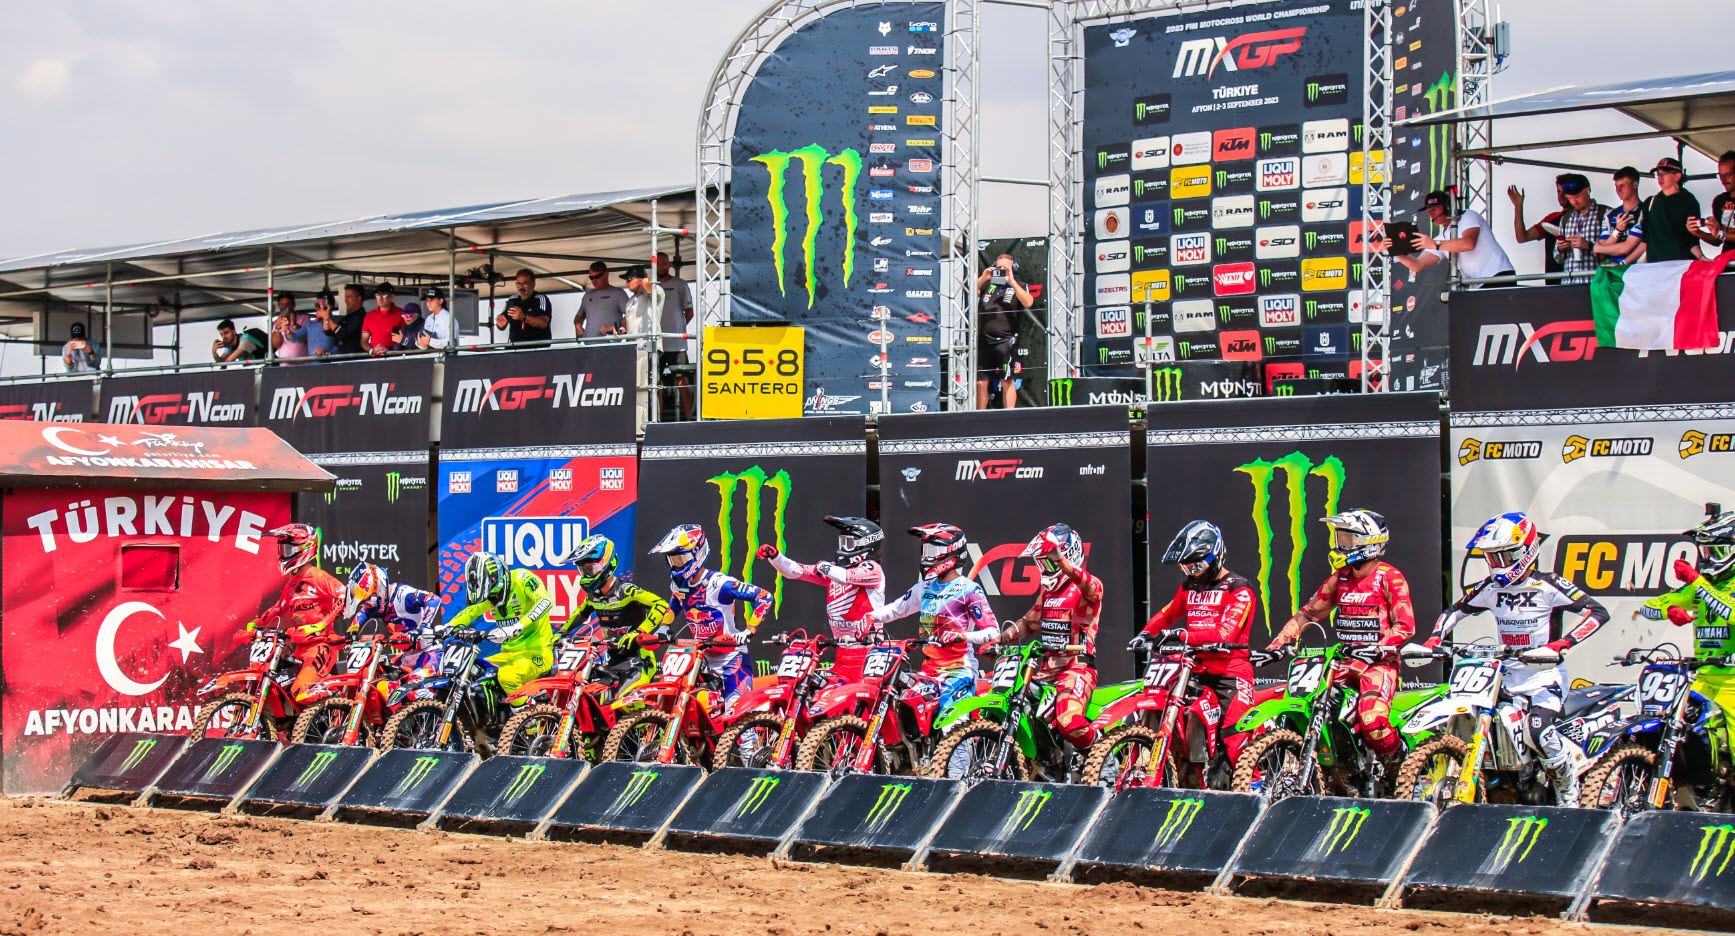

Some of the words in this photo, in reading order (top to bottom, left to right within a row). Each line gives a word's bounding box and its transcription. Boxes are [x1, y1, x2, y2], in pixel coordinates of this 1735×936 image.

[1166, 24, 1184, 34] 2023
[1185, 22, 1199, 31] FIM
[1199, 17, 1245, 29] MOTOCROSS
[1246, 12, 1273, 24] WORLD
[1274, 4, 1330, 20] CHAMPIONSHIP
[1172, 26, 1306, 82] MXGP
[1211, 83, 1259, 100] TÜRKIYE
[1192, 104, 1214, 113] AFYON
[1227, 98, 1264, 110] SEPTEMBER
[1317, 131, 1347, 140] RAM
[1218, 137, 1249, 153] KTM
[1264, 162, 1293, 174] LIQUI
[1263, 174, 1293, 187] MOLY
[1106, 186, 1129, 194] RAM
[1225, 207, 1253, 215] RAM
[1178, 237, 1204, 250] LIQUI
[1177, 250, 1204, 262] MOLY
[1265, 298, 1295, 311] LIQUI
[1101, 310, 1126, 322] LIQUI
[1265, 311, 1295, 323] MOLY
[1102, 322, 1126, 334] MOLY
[1228, 340, 1256, 353] KTM
[707, 383, 799, 395] SANTERO
[46, 454, 259, 471] AFYONKARAHISAR
[450, 473, 470, 484] LIQUI
[498, 471, 517, 482] LIQUI
[551, 470, 572, 481] LIQUI
[602, 469, 623, 480] LIQUI
[450, 483, 471, 493] MOLY
[497, 482, 517, 492] MOLY
[551, 480, 572, 490] MOLY
[601, 479, 623, 490] MOLY
[323, 540, 400, 564] MONSTER
[1187, 590, 1222, 605] KENNY
[1696, 585, 1731, 622] YAMAHA
[528, 599, 552, 622] YAMAHA
[1337, 631, 1379, 642] Kawasaki
[1696, 627, 1729, 640] YAMAHA
[250, 641, 274, 662] 123
[347, 646, 371, 669] 79
[557, 650, 586, 671] 51
[662, 653, 692, 676] 80
[1142, 663, 1181, 688] 517
[1288, 663, 1322, 696] 24
[1450, 666, 1494, 693] 96
[1641, 671, 1685, 703] 93
